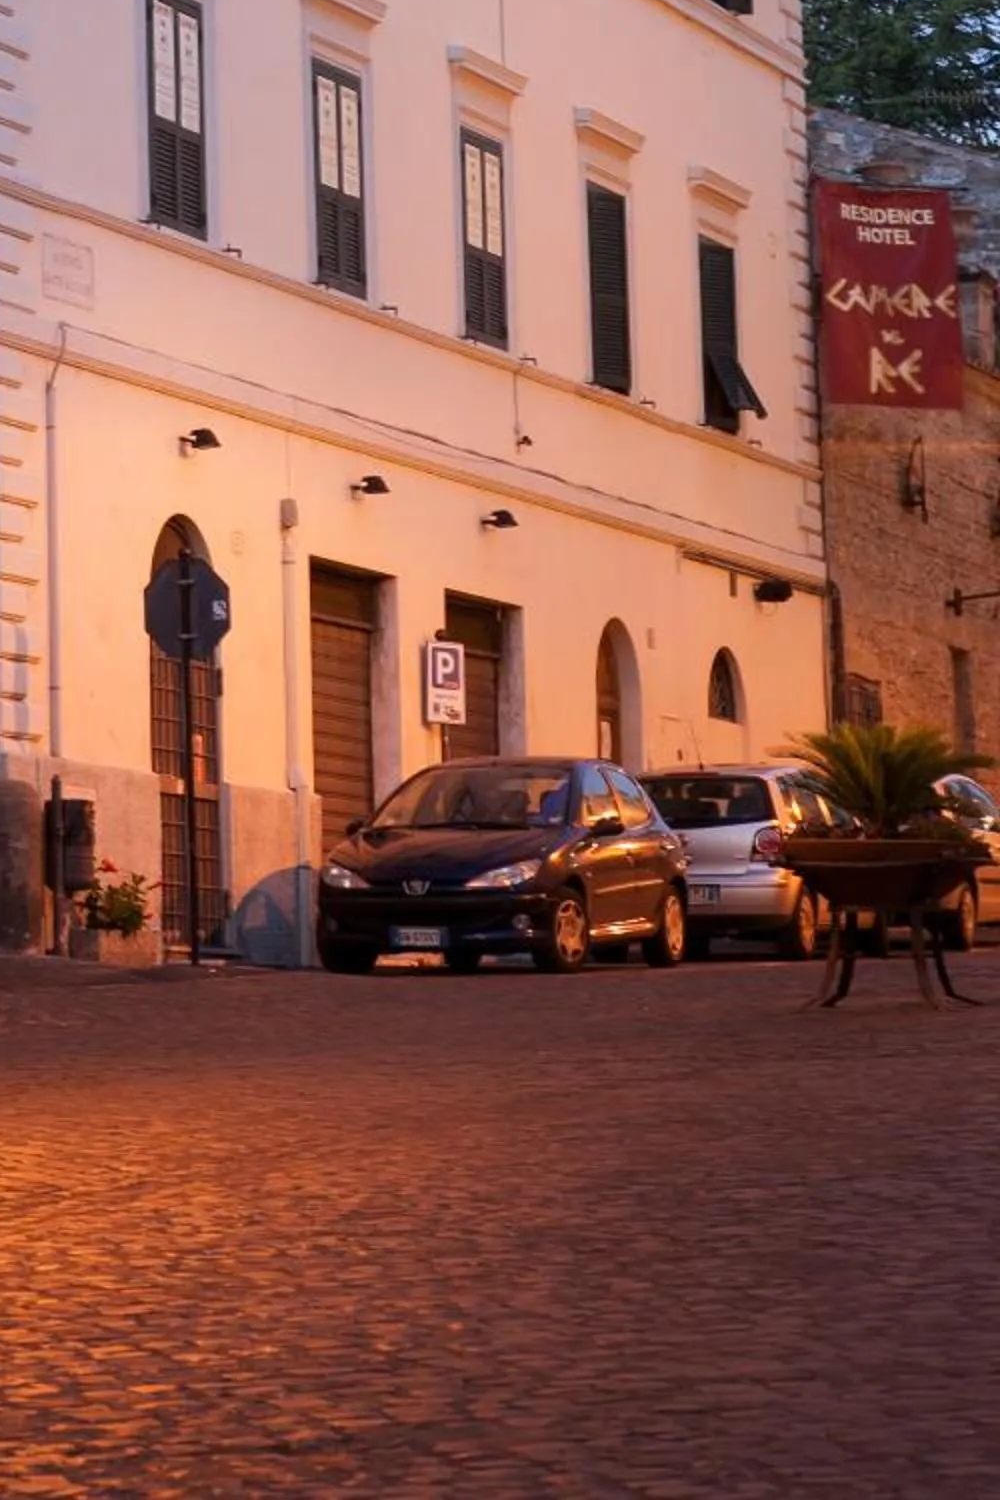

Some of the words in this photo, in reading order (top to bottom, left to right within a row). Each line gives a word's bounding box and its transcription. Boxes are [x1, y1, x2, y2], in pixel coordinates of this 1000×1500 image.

[840, 202, 935, 225] RESIDENCE
[857, 226, 916, 245] HOTEL
[825, 277, 957, 318] CAMERE
[869, 346, 926, 394] RE
[436, 651, 455, 686] P
